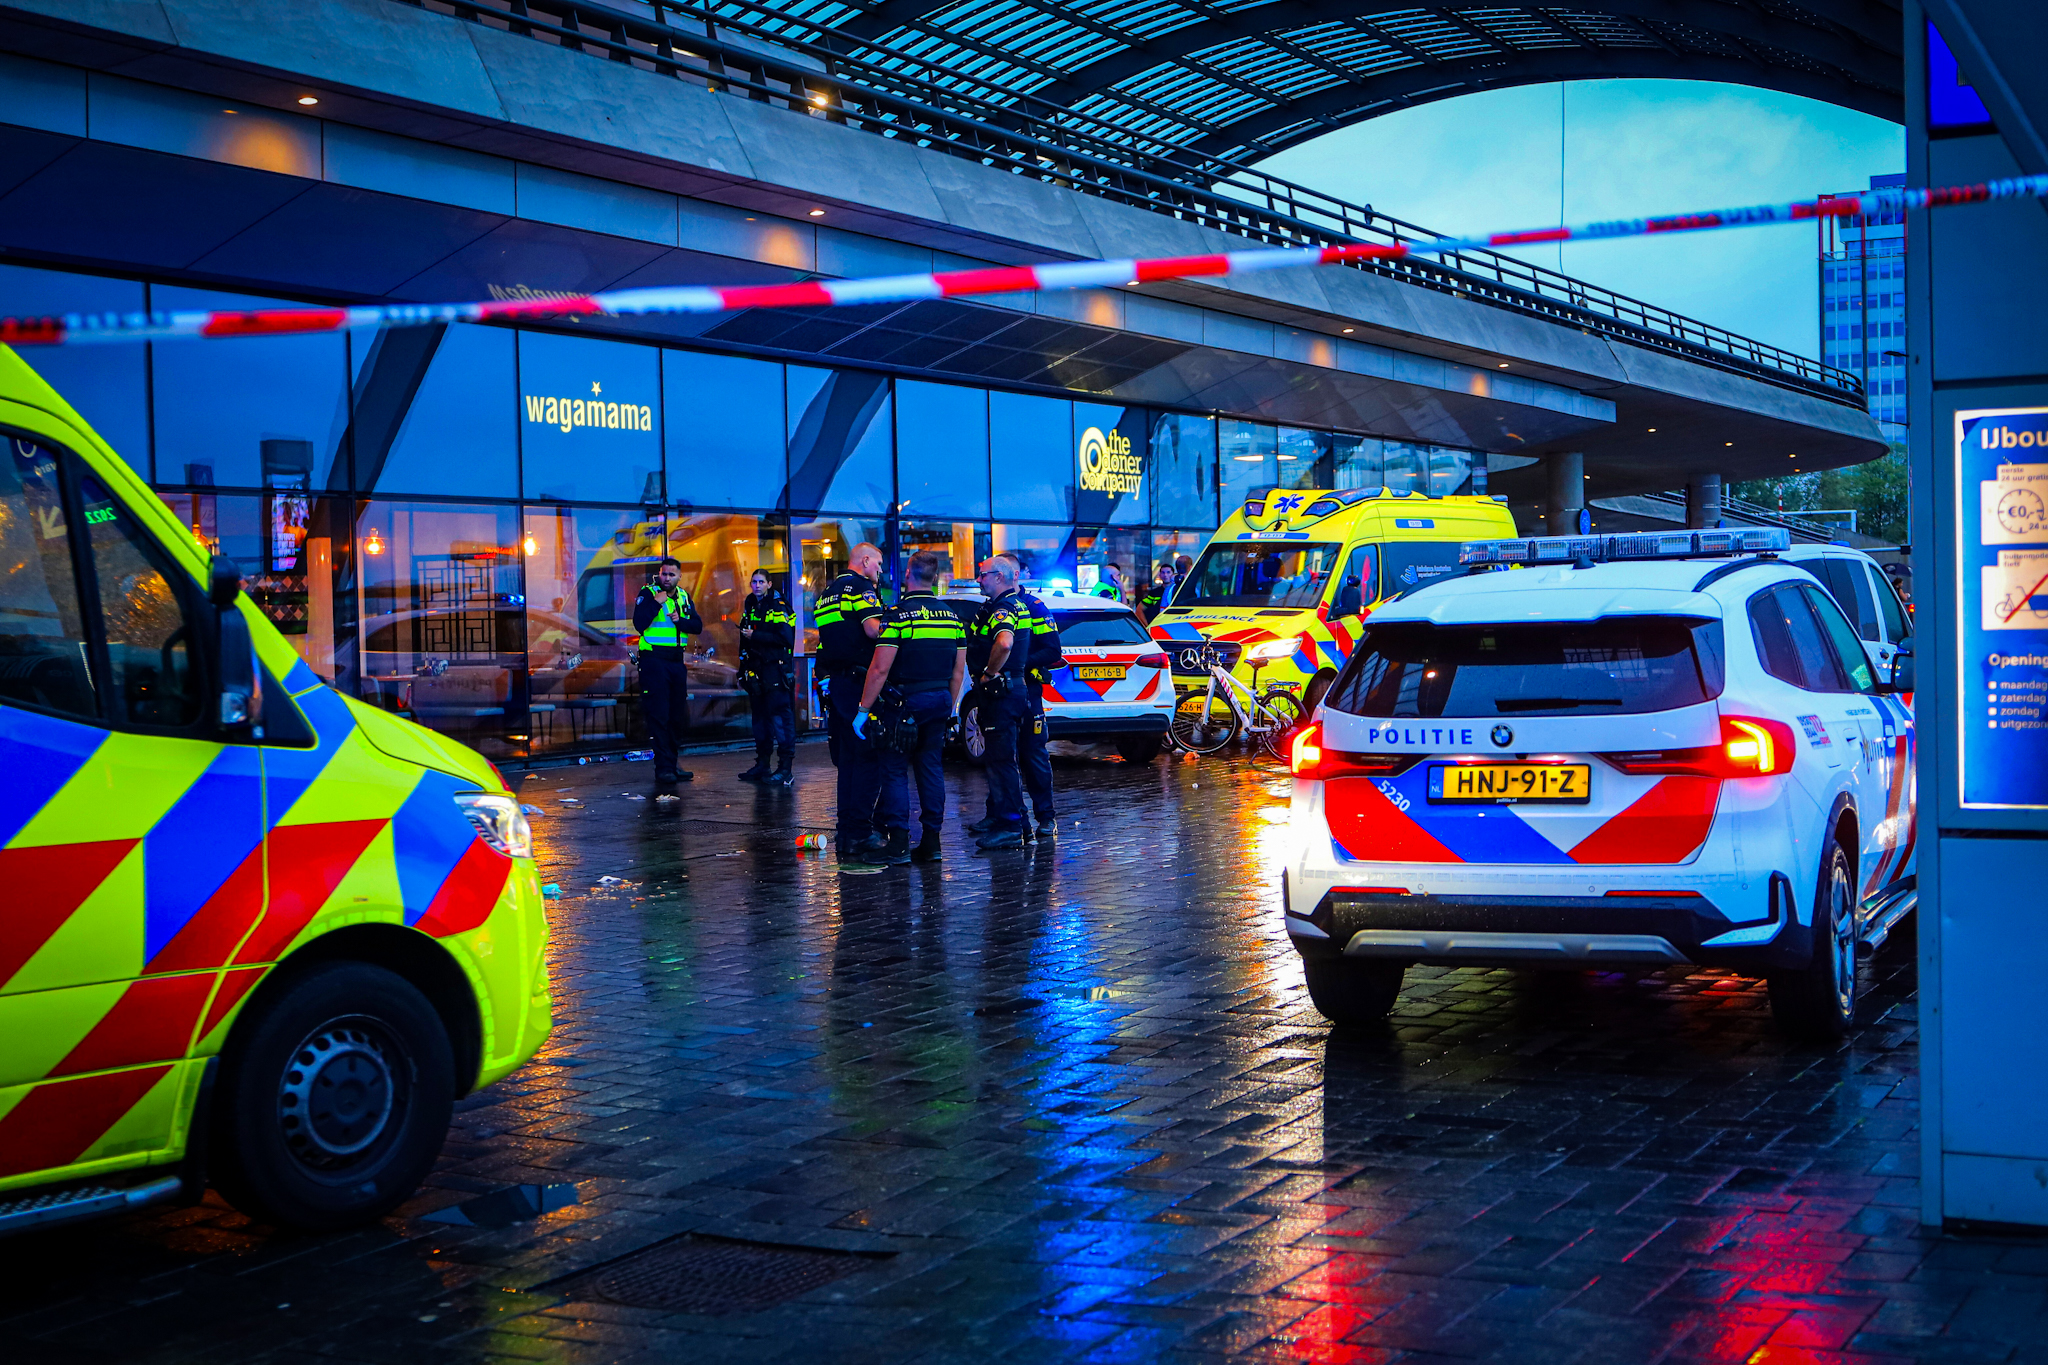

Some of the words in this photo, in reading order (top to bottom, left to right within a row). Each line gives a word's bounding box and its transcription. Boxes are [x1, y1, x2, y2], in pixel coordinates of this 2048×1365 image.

[525, 395, 652, 433] wagamama
[1108, 429, 1131, 455] the
[1981, 426, 2048, 449] IJbou
[1101, 447, 1142, 474] doner
[1080, 471, 1142, 500] company
[2029, 522, 2040, 531] 24
[1988, 653, 2048, 669] Opening
[1082, 667, 1121, 677] GPK-16-B
[2000, 680, 2048, 691] maandag
[2000, 693, 2047, 705] zaterdag
[1179, 703, 1204, 711] 626-H
[2000, 706, 2040, 718] zondag
[2000, 719, 2048, 731] uitgezon
[1369, 728, 1473, 745] POLITIE
[1431, 785, 1441, 793] NL
[1457, 770, 1575, 794] HNJ-91-Z
[1377, 780, 1411, 812] 5230
[1496, 796, 1518, 804] politie.nl
